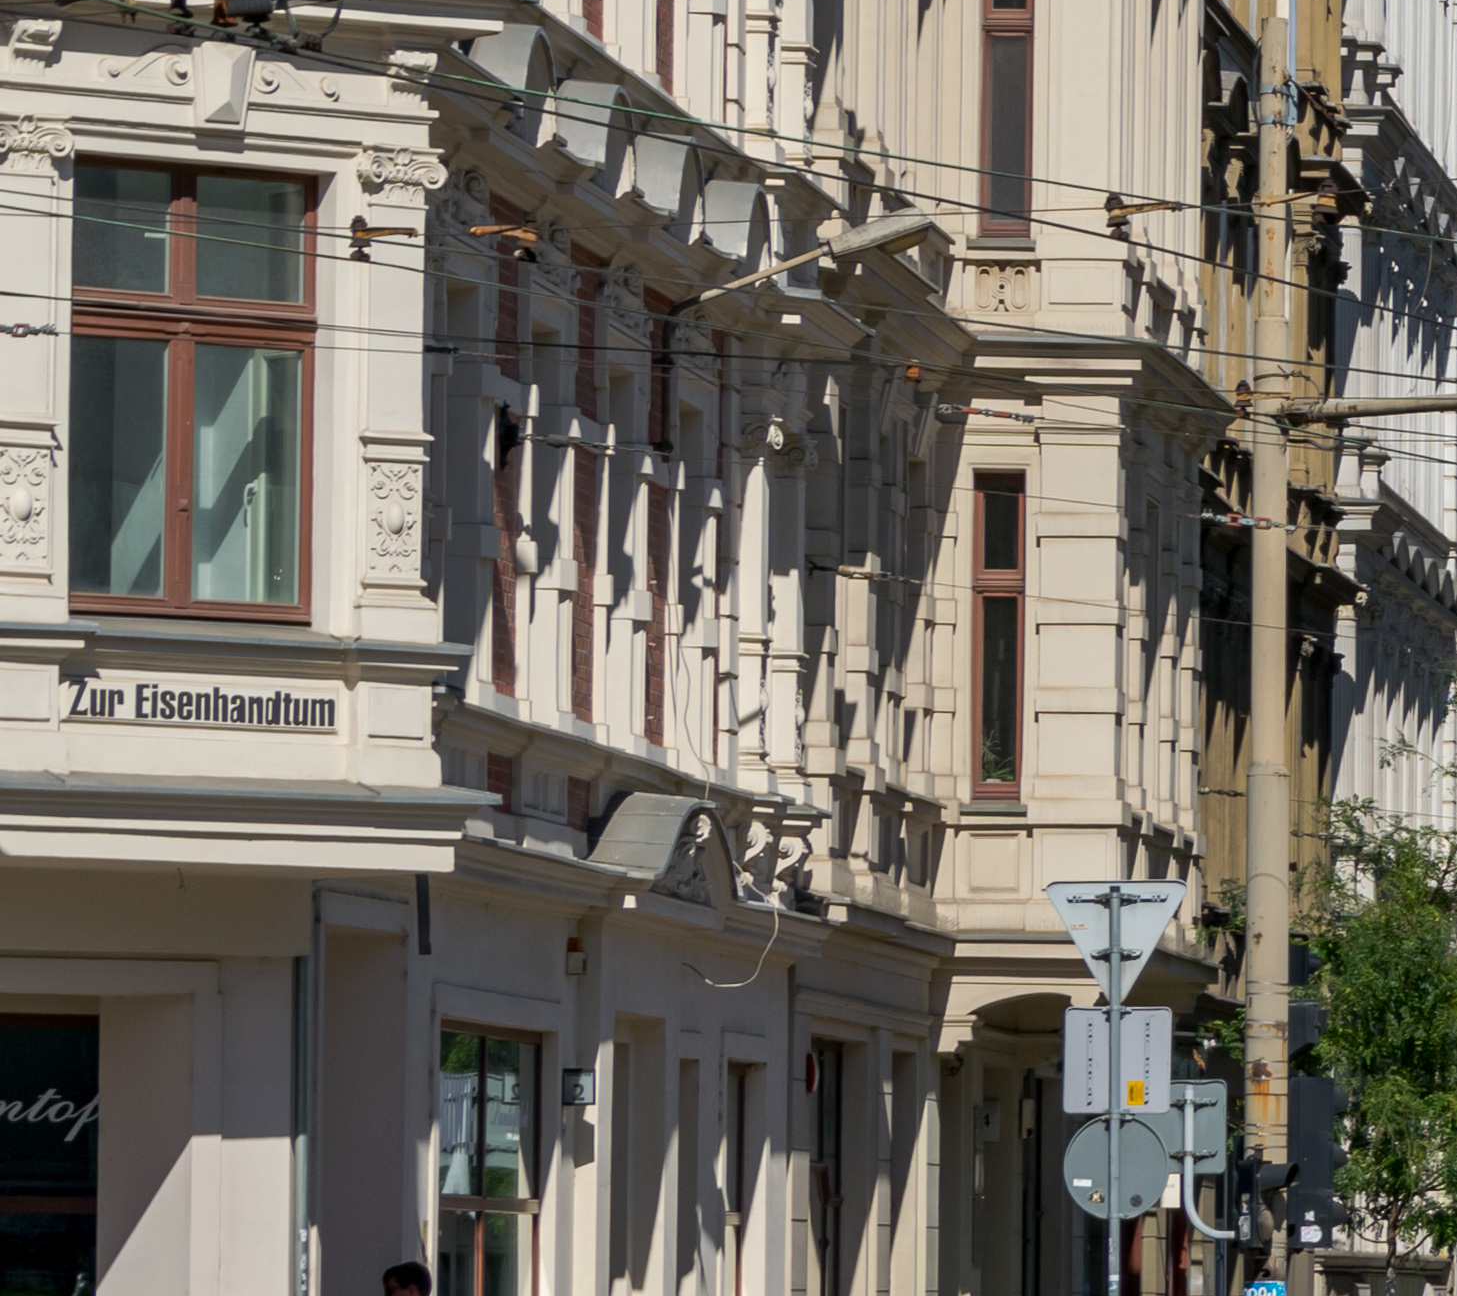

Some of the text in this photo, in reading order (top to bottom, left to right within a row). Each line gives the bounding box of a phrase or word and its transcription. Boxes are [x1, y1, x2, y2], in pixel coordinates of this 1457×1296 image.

[69, 681, 337, 728] Zur Eisenhandtum
[573, 1083, 586, 1101] 2
